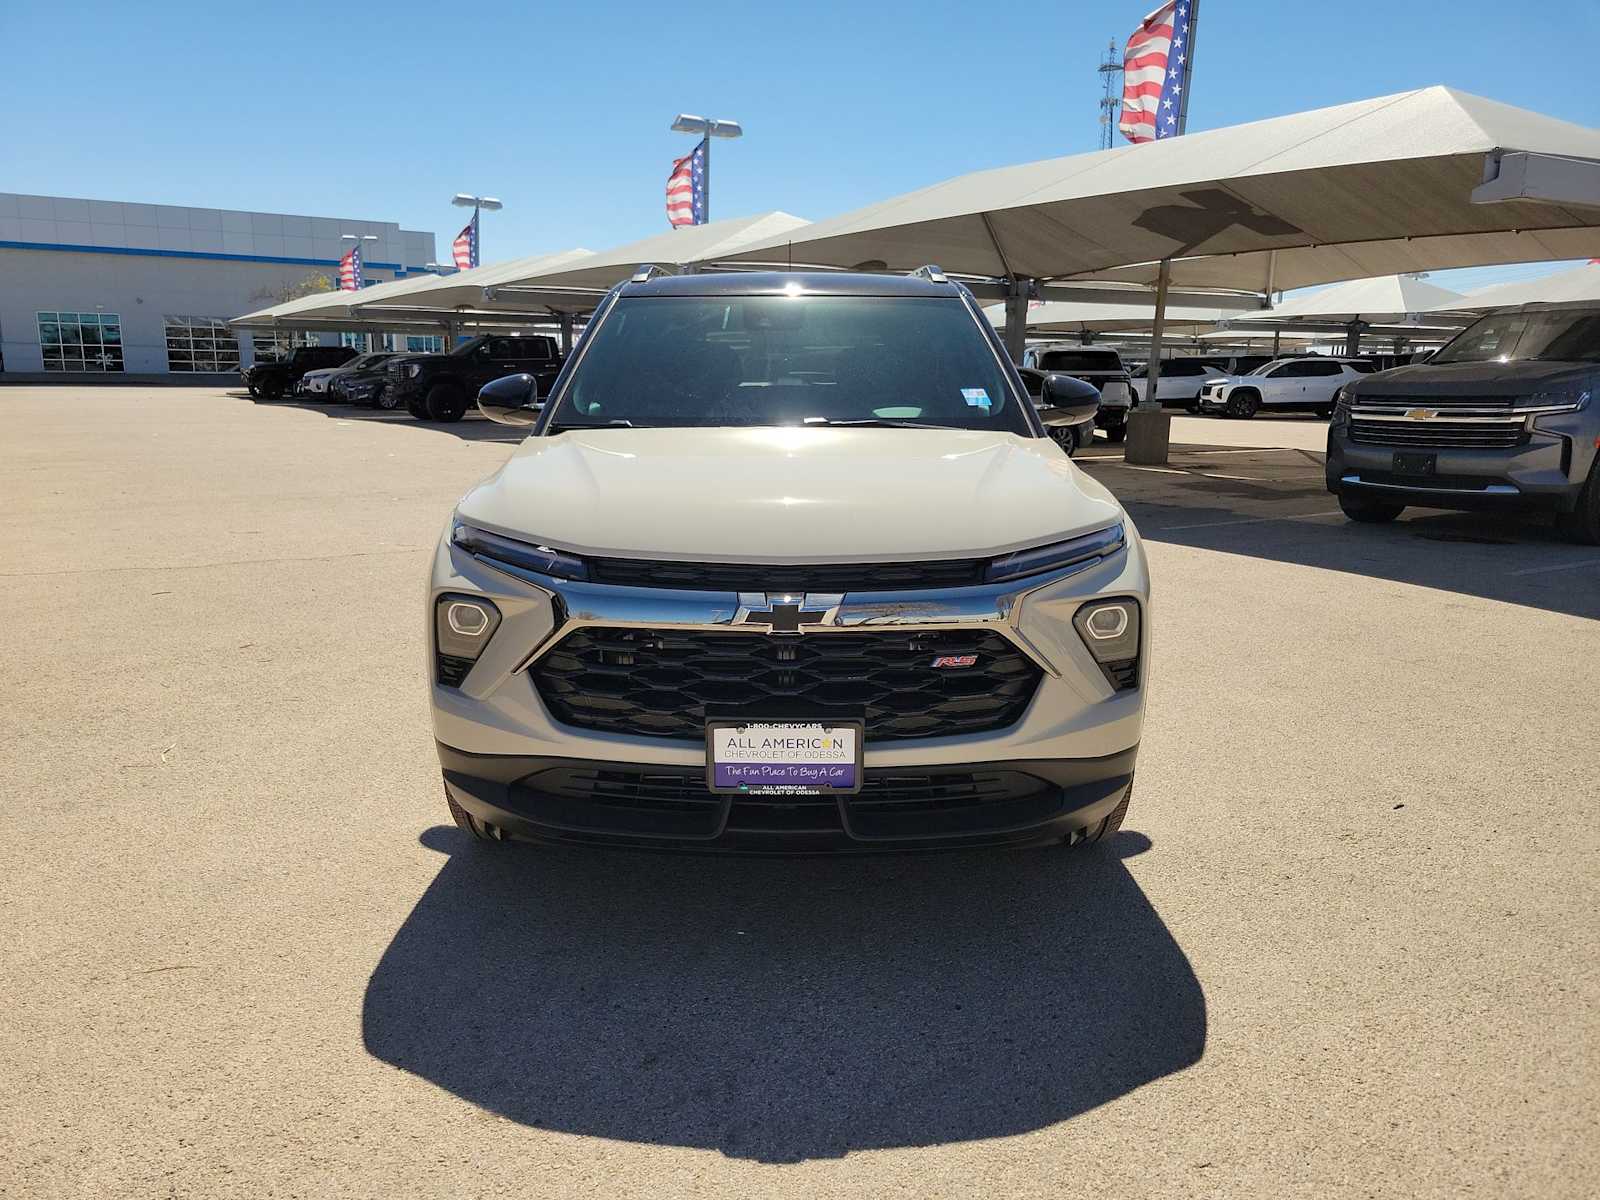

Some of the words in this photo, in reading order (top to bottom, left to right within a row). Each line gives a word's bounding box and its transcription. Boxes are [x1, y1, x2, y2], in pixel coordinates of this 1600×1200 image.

[931, 655, 978, 668] RS
[727, 738, 756, 749] ALL
[724, 750, 784, 759] CHEVROLET
[788, 750, 801, 759] OF
[804, 750, 846, 759] ODESSA
[726, 766, 742, 776] The
[743, 766, 760, 776] Fun
[761, 766, 785, 776] Place
[787, 766, 798, 777] To
[800, 766, 818, 779] Buy
[819, 767, 827, 777] A
[829, 766, 845, 777] Car
